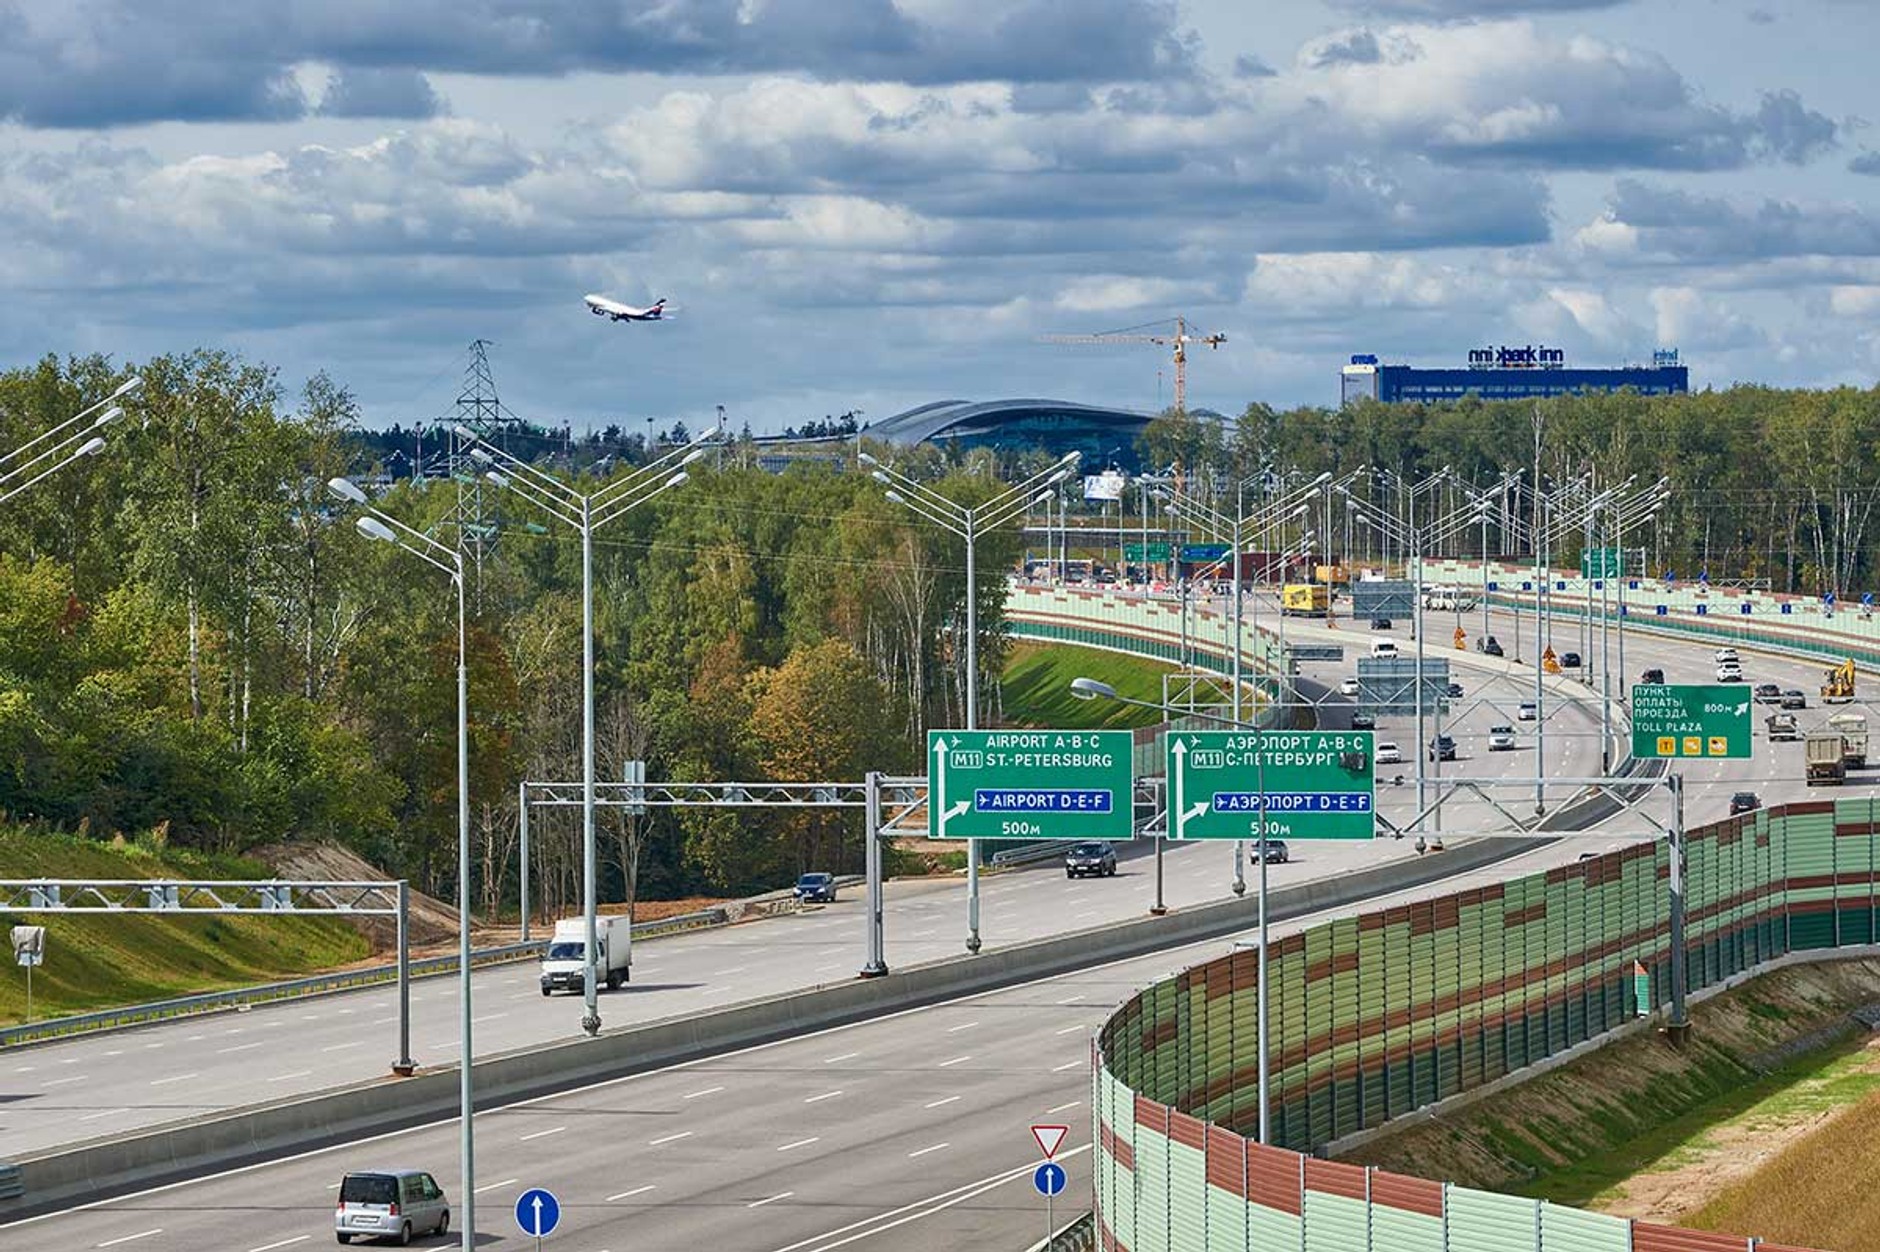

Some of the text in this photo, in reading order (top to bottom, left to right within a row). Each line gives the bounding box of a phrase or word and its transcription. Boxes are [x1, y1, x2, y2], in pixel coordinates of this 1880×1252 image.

[1539, 345, 1563, 361] inn
[1634, 686, 1673, 697] ПУНКТ
[1634, 697, 1683, 707] ОПЛАТЫ
[1634, 708, 1688, 718] ПРОЕЗДА
[1635, 722, 1703, 732] TOLL PLAZA
[986, 735, 1100, 748] AIRPORT A-B-C
[1226, 736, 1311, 750] АЭРОПОРТ
[954, 753, 1113, 767] M11 ST.-PETERSBURG
[992, 794, 1103, 808] AIRPORT D-E-F
[1229, 796, 1368, 809] АЭРОПОРТ D-E-F
